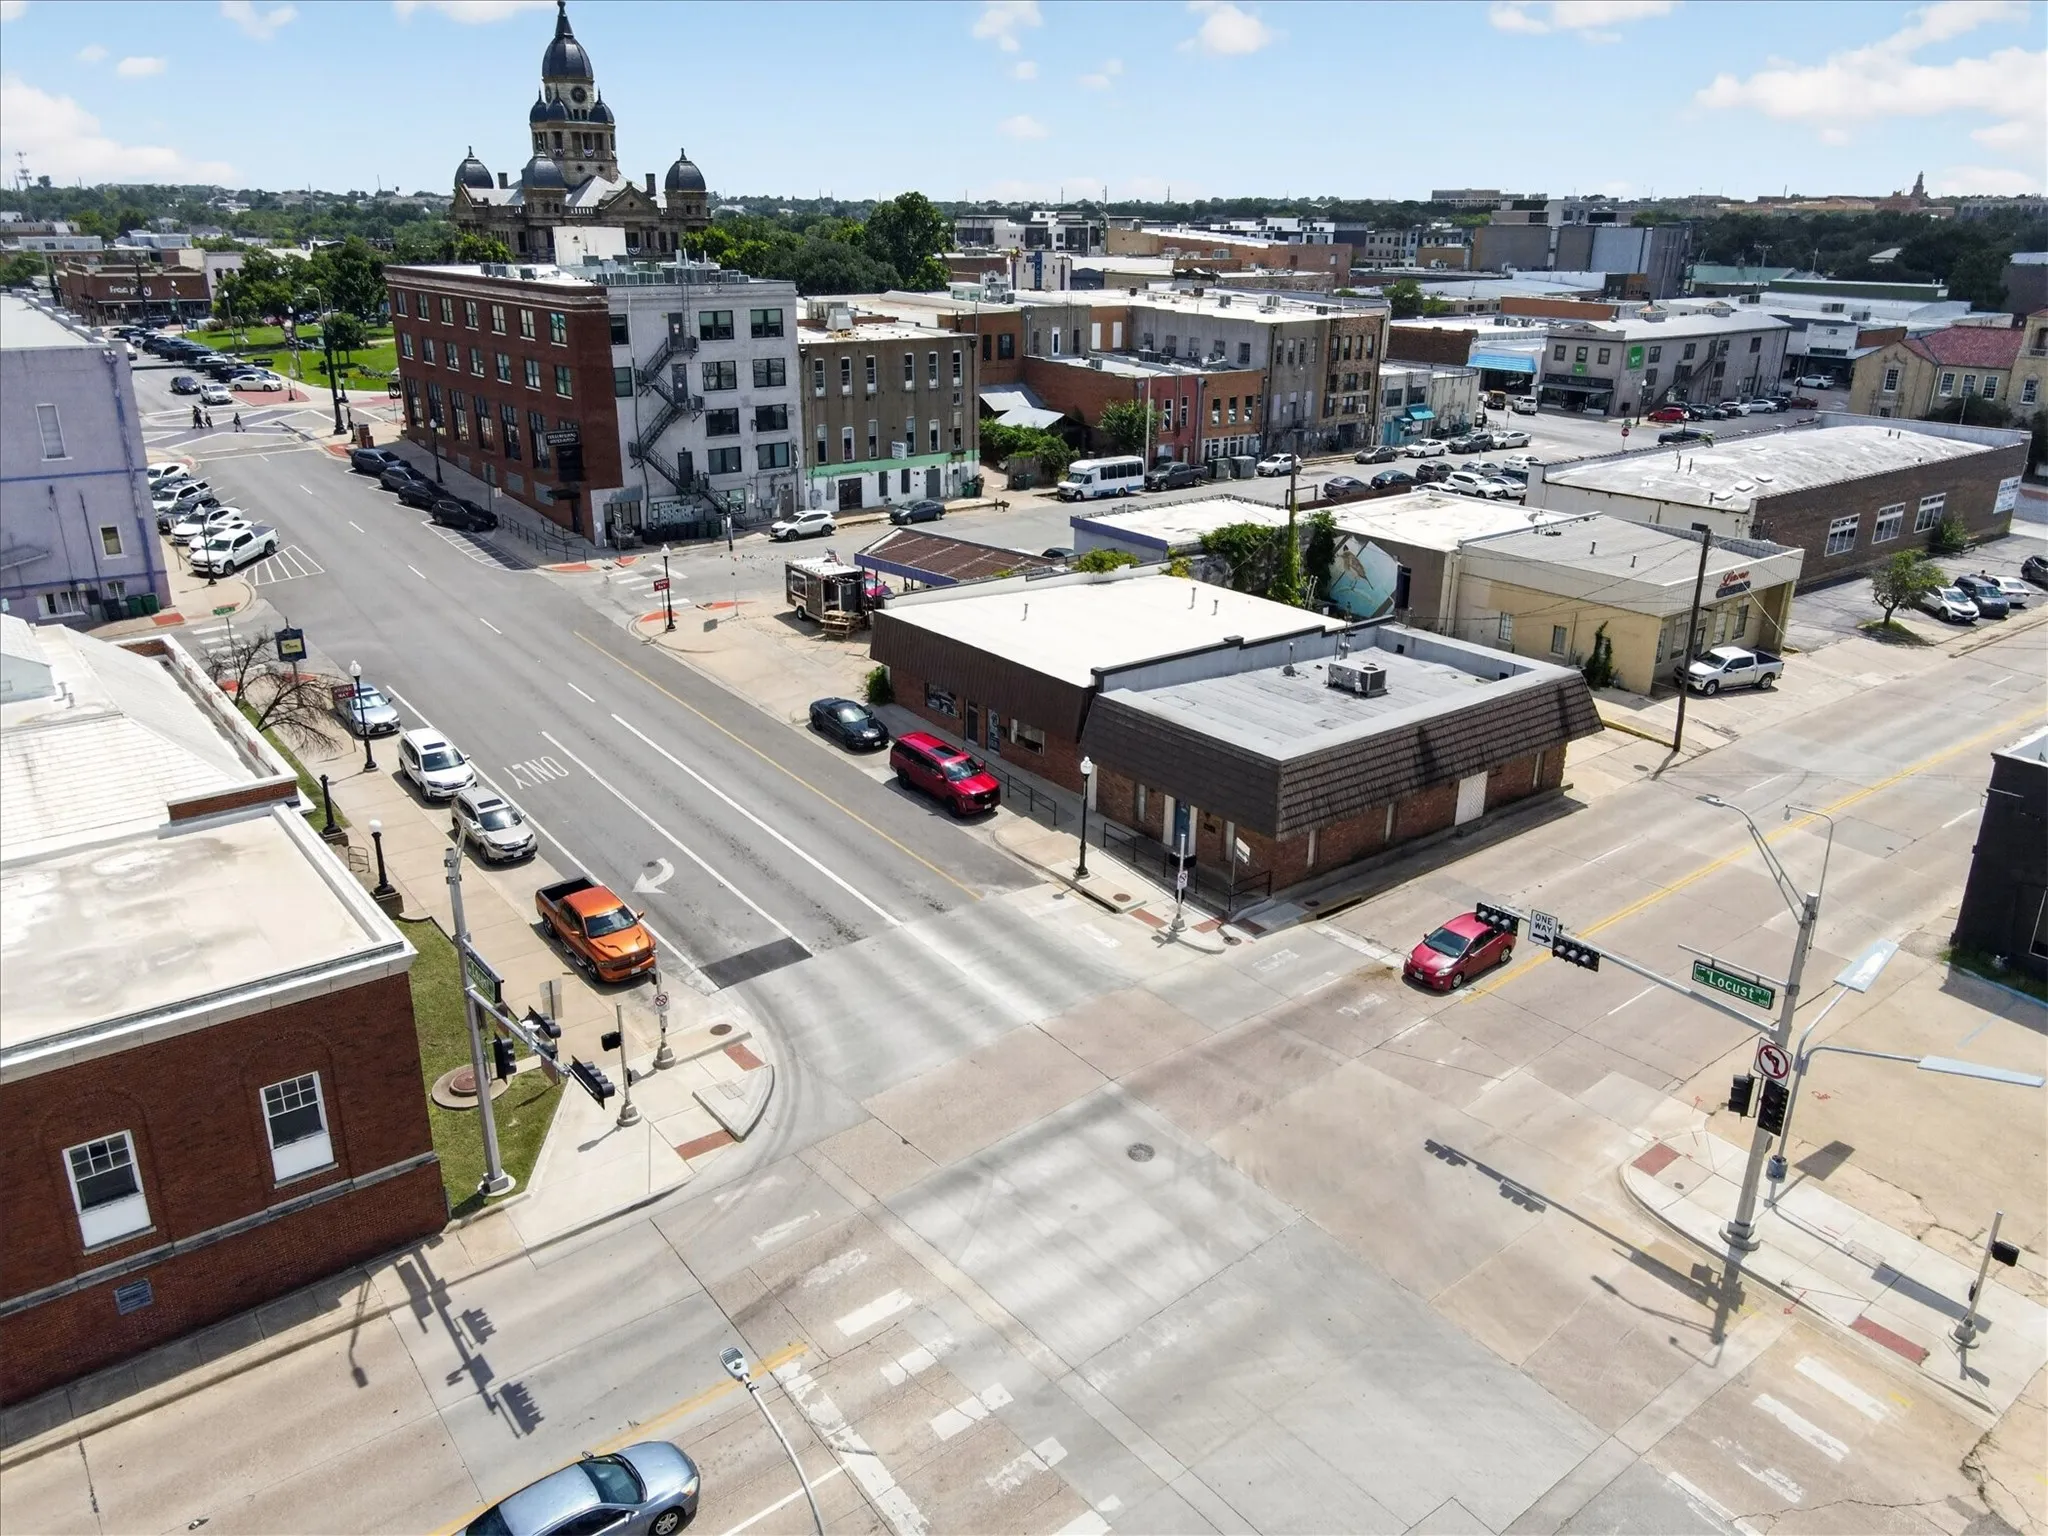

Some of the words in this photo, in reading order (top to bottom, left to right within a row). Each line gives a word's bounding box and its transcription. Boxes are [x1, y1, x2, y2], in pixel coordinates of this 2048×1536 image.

[130, 286, 152, 297] py
[503, 755, 569, 790] ONLY
[1535, 913, 1553, 926] ONE
[1534, 922, 1553, 934] WAY
[1708, 971, 1754, 1000] Locust
